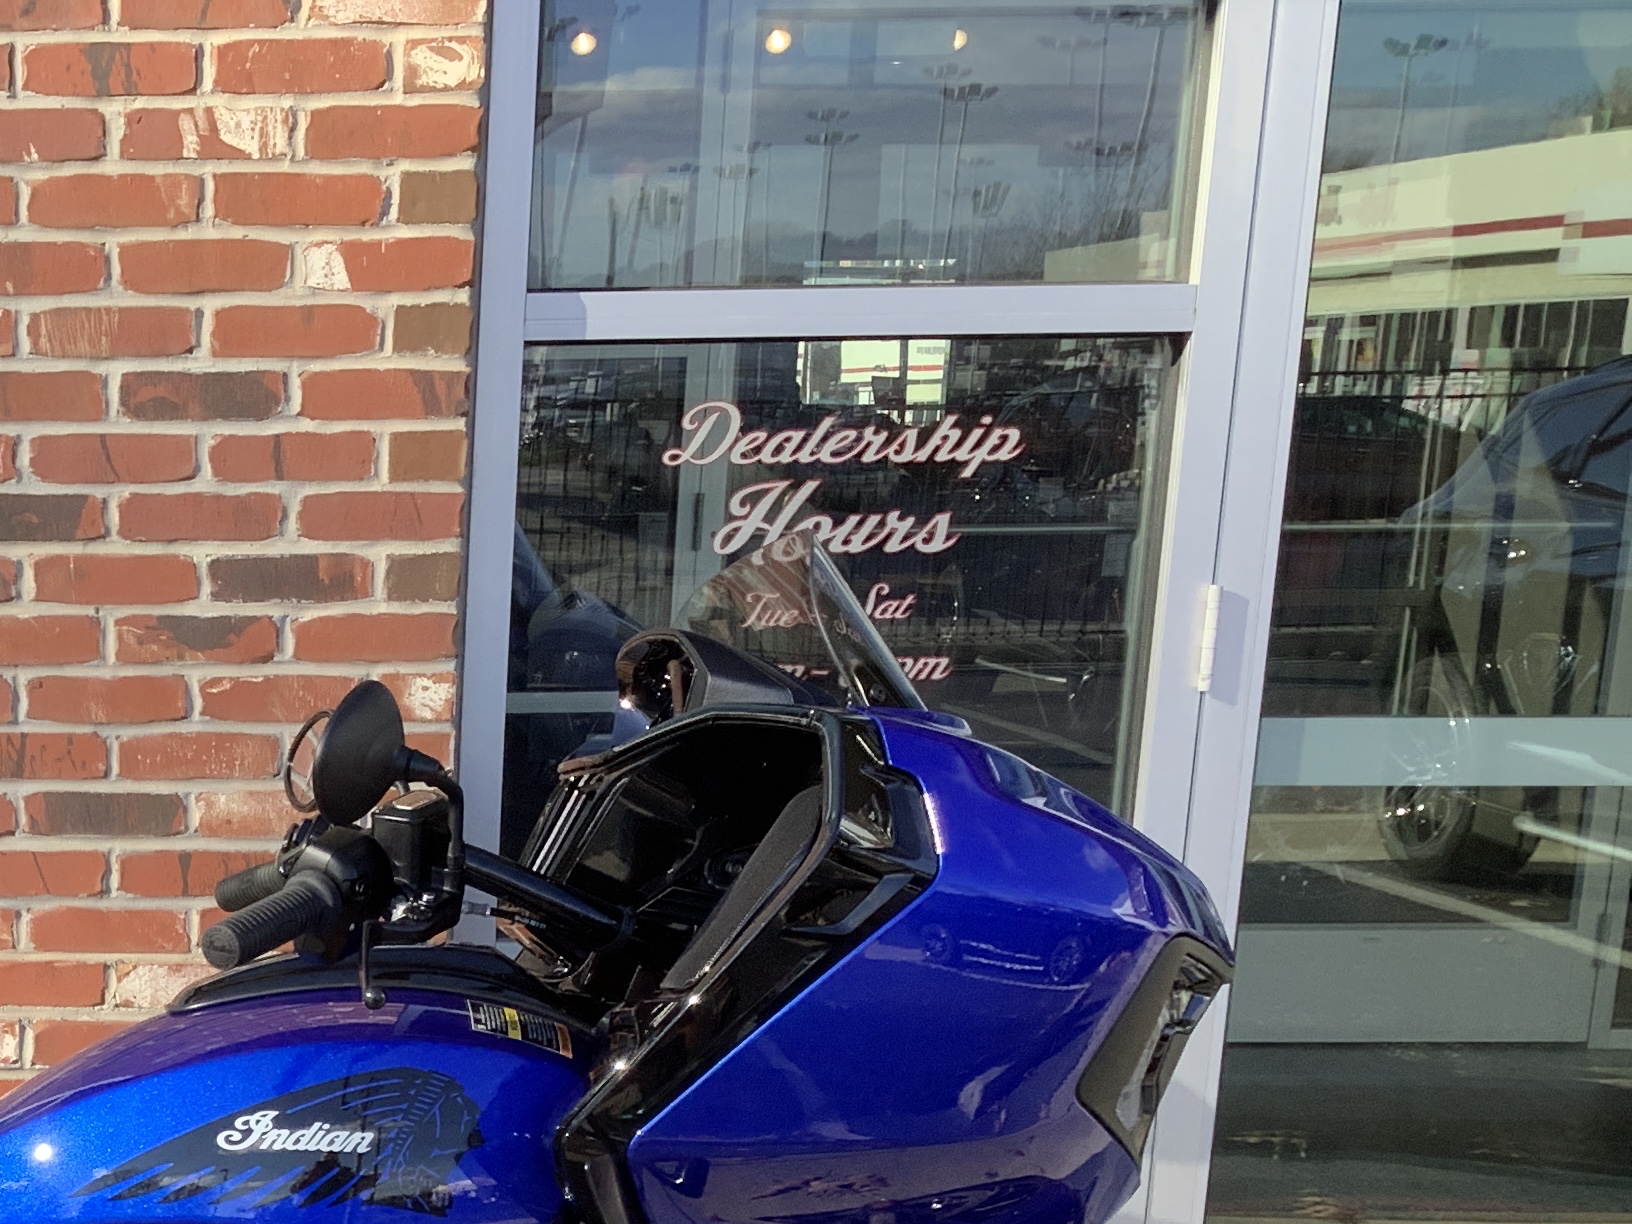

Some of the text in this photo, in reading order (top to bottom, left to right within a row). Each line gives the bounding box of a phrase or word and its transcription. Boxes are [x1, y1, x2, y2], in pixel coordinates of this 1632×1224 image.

[662, 401, 1025, 477] Dealership
[713, 478, 962, 555] Hours
[864, 582, 917, 620] Sat
[216, 1110, 374, 1154] Indian
